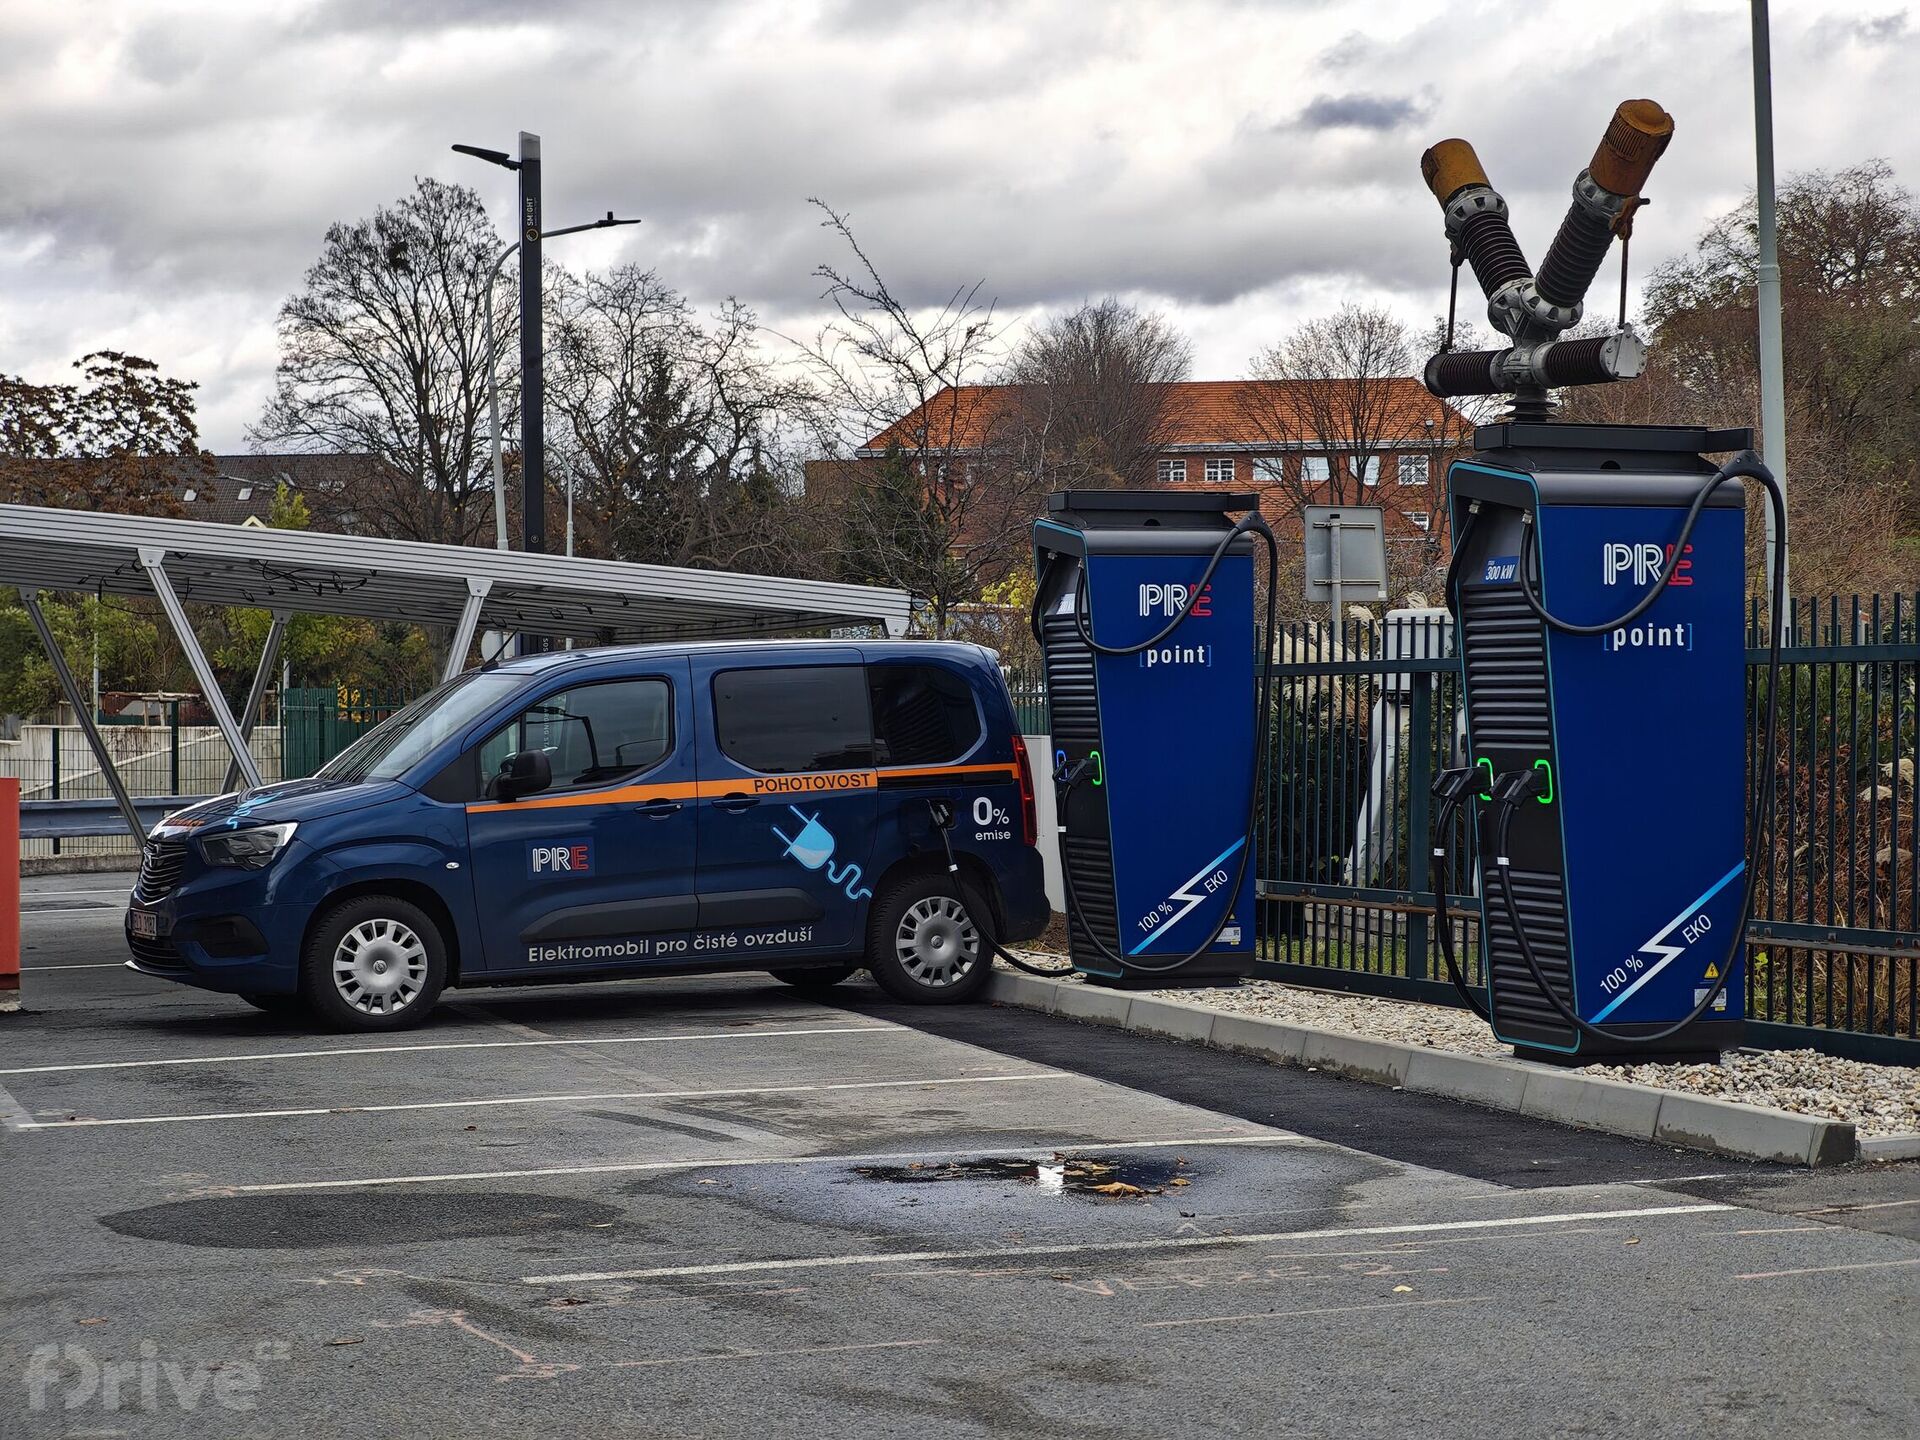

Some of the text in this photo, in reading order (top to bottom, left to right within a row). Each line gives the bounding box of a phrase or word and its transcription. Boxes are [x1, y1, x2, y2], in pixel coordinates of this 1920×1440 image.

[1485, 564, 1516, 581] 300 kW
[1604, 543, 1693, 585] PRE
[1139, 583, 1212, 616] PRE
[753, 773, 870, 793] POHOTOVOST
[975, 829, 1011, 841] emise
[532, 845, 589, 873] PRE
[1137, 870, 1228, 932] 100 % EKO
[528, 926, 813, 962] Elektromobil pro čisté ovzduší
[1600, 914, 1712, 994] 100 % EKO
